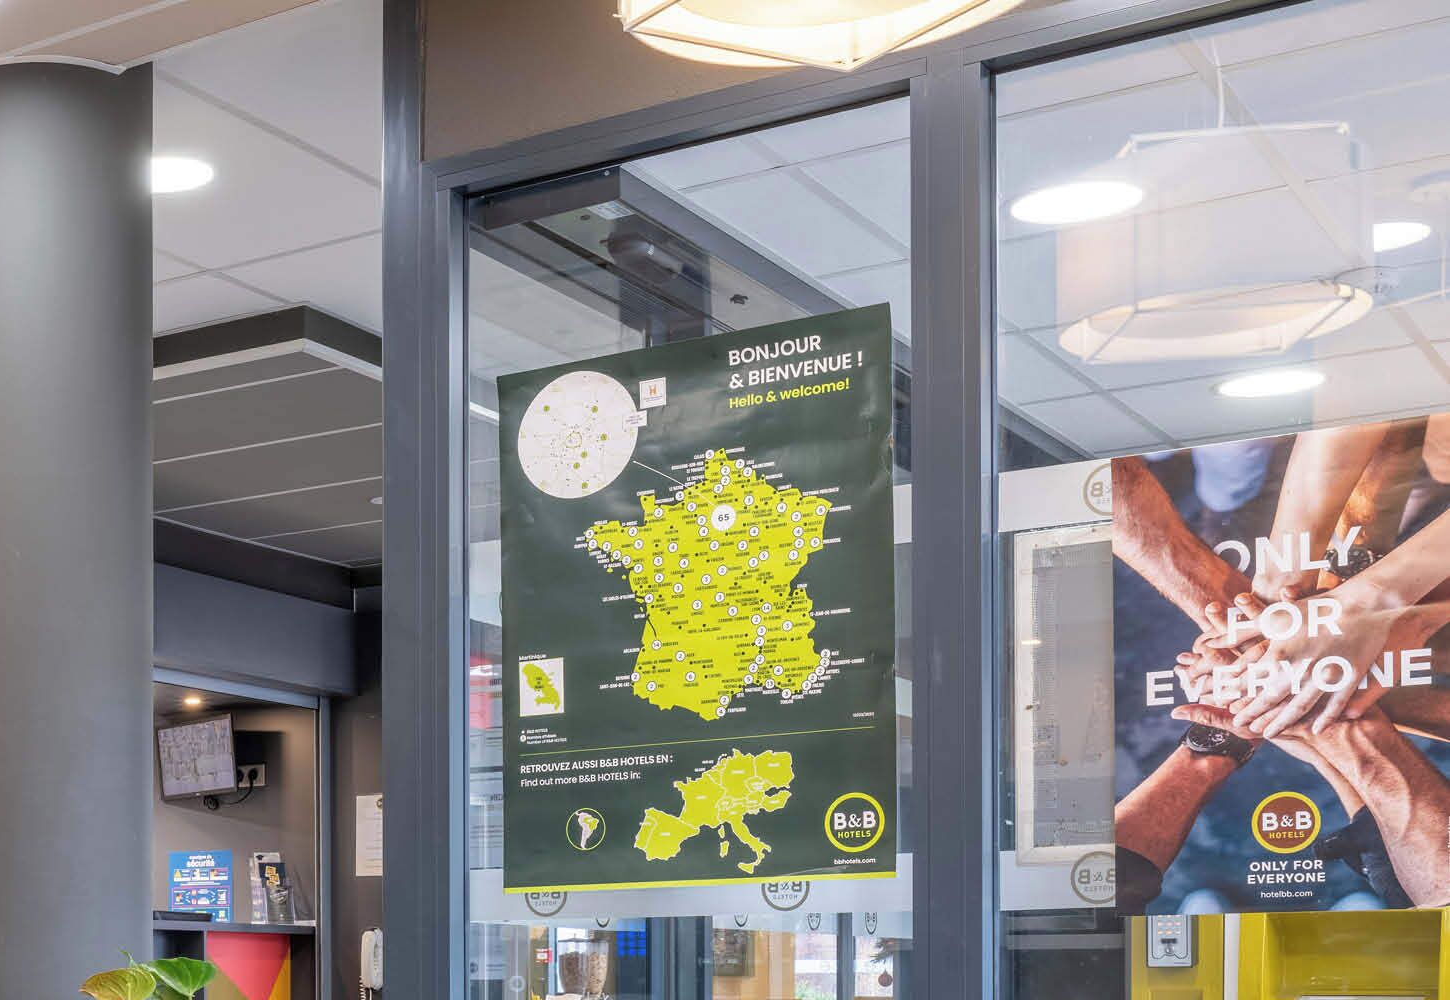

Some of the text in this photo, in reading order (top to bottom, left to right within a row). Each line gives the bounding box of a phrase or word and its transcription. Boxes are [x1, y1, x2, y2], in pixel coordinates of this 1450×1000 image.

[729, 335, 821, 366] BONJOUR
[729, 351, 863, 389] & BIENVENUE !
[729, 377, 850, 409] Hello & welcome!
[718, 513, 730, 522] 65
[1212, 526, 1363, 576] ONLY
[1227, 597, 1343, 645] FOR
[518, 653, 547, 661] Martinique
[1146, 648, 1432, 706] EVERYONE
[520, 762, 570, 774] RETROUVEZ
[572, 760, 598, 770] AUSSI
[600, 758, 619, 768] B&B
[620, 755, 655, 766] HOTELS
[520, 770, 641, 788] Find out more B&B HOTELS in:
[834, 810, 876, 830] B&B
[1262, 811, 1312, 831] B&B
[837, 830, 871, 839] HOTELS
[1269, 831, 1305, 839] HOTELS
[1250, 859, 1323, 871] ONLY FOR
[1247, 872, 1326, 885] EVERYONE
[1260, 890, 1313, 899] hotelbb.com
